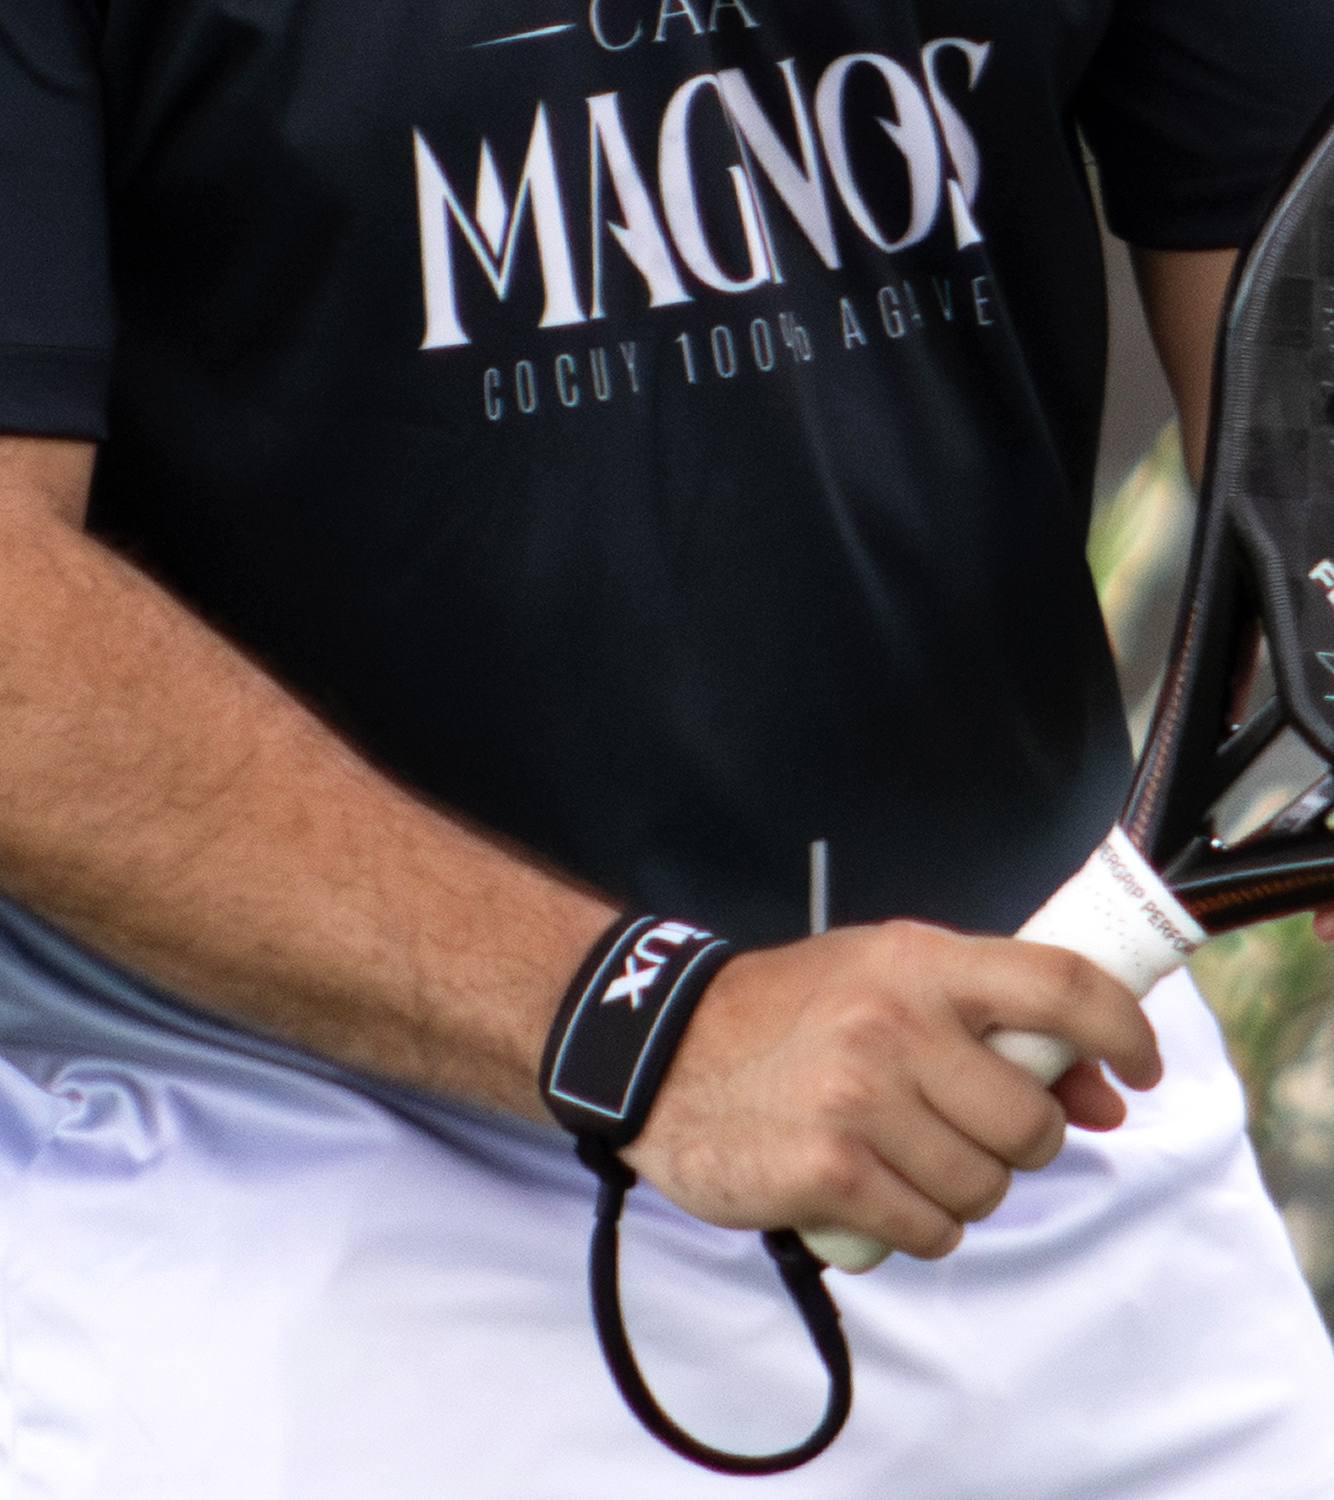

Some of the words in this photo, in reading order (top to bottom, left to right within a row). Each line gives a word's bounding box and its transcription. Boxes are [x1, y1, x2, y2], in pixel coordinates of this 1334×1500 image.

[412, 37, 991, 350] MAGNOS
[482, 340, 640, 421] COCUY
[600, 920, 714, 1010] IUX
